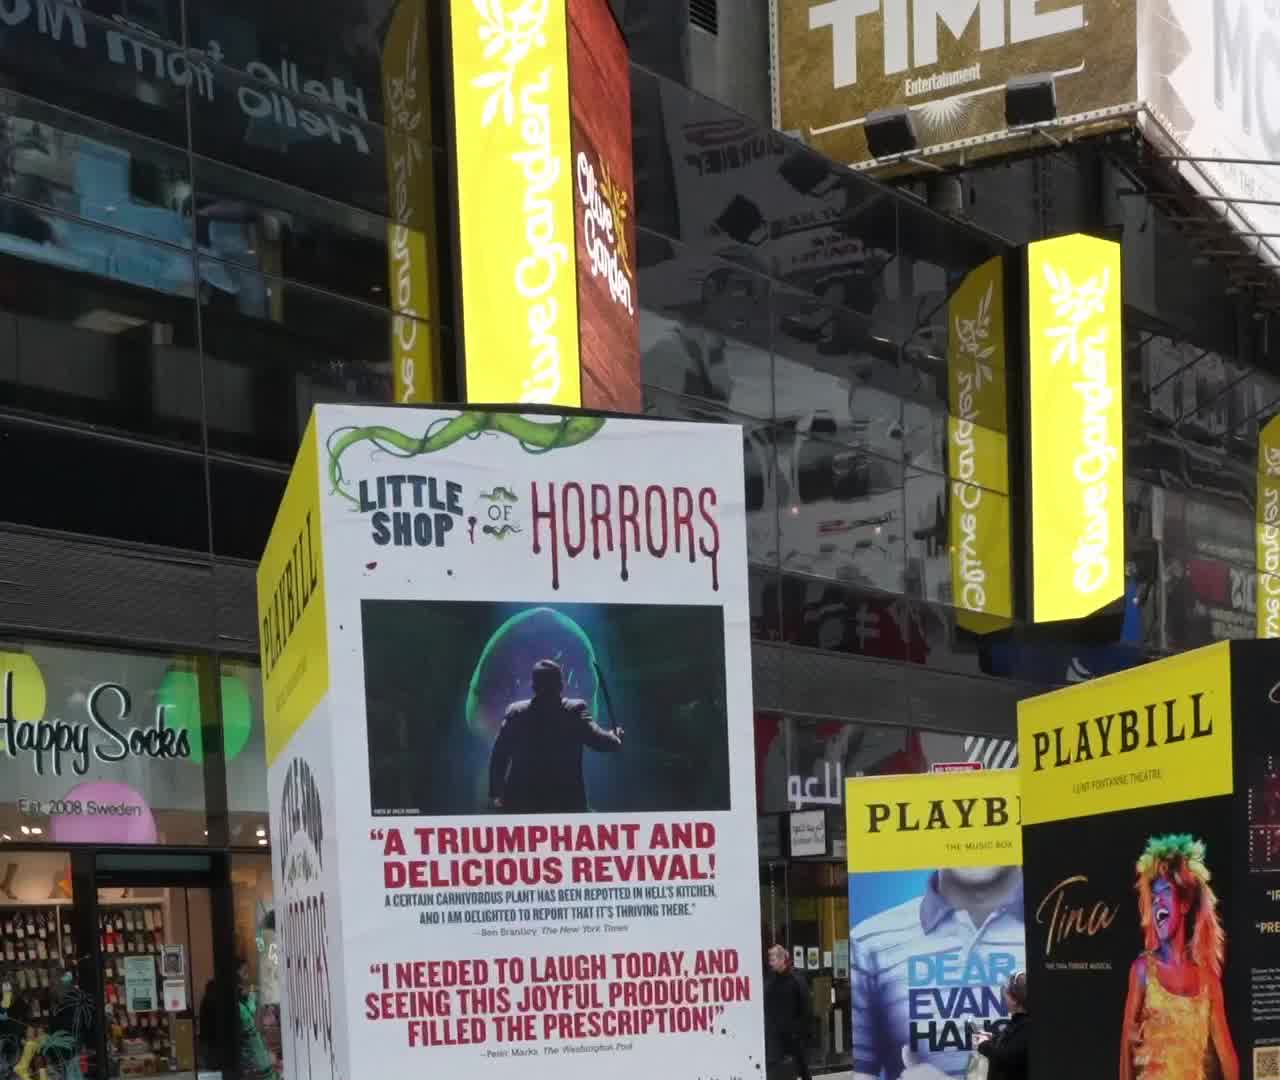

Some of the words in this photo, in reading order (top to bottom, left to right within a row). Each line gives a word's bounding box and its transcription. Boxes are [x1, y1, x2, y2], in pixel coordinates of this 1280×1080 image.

[904, 61, 981, 96] Entertainment
[515, 64, 568, 297] Garden
[577, 151, 613, 240] Olive
[584, 207, 633, 315] Garden
[1072, 328, 1117, 483] Garden
[358, 474, 463, 515] LITTLE
[487, 504, 513, 521] OF
[371, 512, 453, 546] SHOP
[530, 480, 719, 591] HORRORS
[1072, 484, 1111, 593] Olive
[263, 511, 317, 681] PLAYBILL
[88, 682, 190, 761] Socks
[1032, 692, 1213, 771] PLAYBILL
[86, 800, 141, 815] Sweden
[866, 796, 1020, 832] PLAYB
[414, 823, 640, 854] TRIUMPHANT
[648, 822, 715, 849] AND
[383, 857, 563, 888] DELICIOUS
[571, 853, 715, 883] REVIVAL!
[420, 911, 439, 924] AND
[447, 910, 462, 923] AM
[464, 909, 516, 923] DELIGHTED
[533, 907, 568, 920] REPORT
[572, 906, 593, 919] THAT
[615, 904, 659, 917] THRIVING
[505, 889, 535, 903] PLANT
[538, 888, 555, 902] HAS
[1036, 875, 1119, 955] Tina
[395, 959, 489, 987] NEEDED
[494, 957, 524, 984] TO
[529, 954, 606, 982] LAUGH
[611, 951, 688, 980] TODAY,
[694, 949, 738, 975] AND
[908, 952, 1016, 985] DEAR
[365, 990, 450, 1020] SEEING
[456, 987, 510, 1015] THIS
[516, 982, 603, 1013] JOYFUL
[608, 976, 750, 1007] PRODUCTION
[909, 987, 1007, 1018] EVAN
[407, 1017, 487, 1047] FILLED
[491, 1014, 537, 1042] THE
